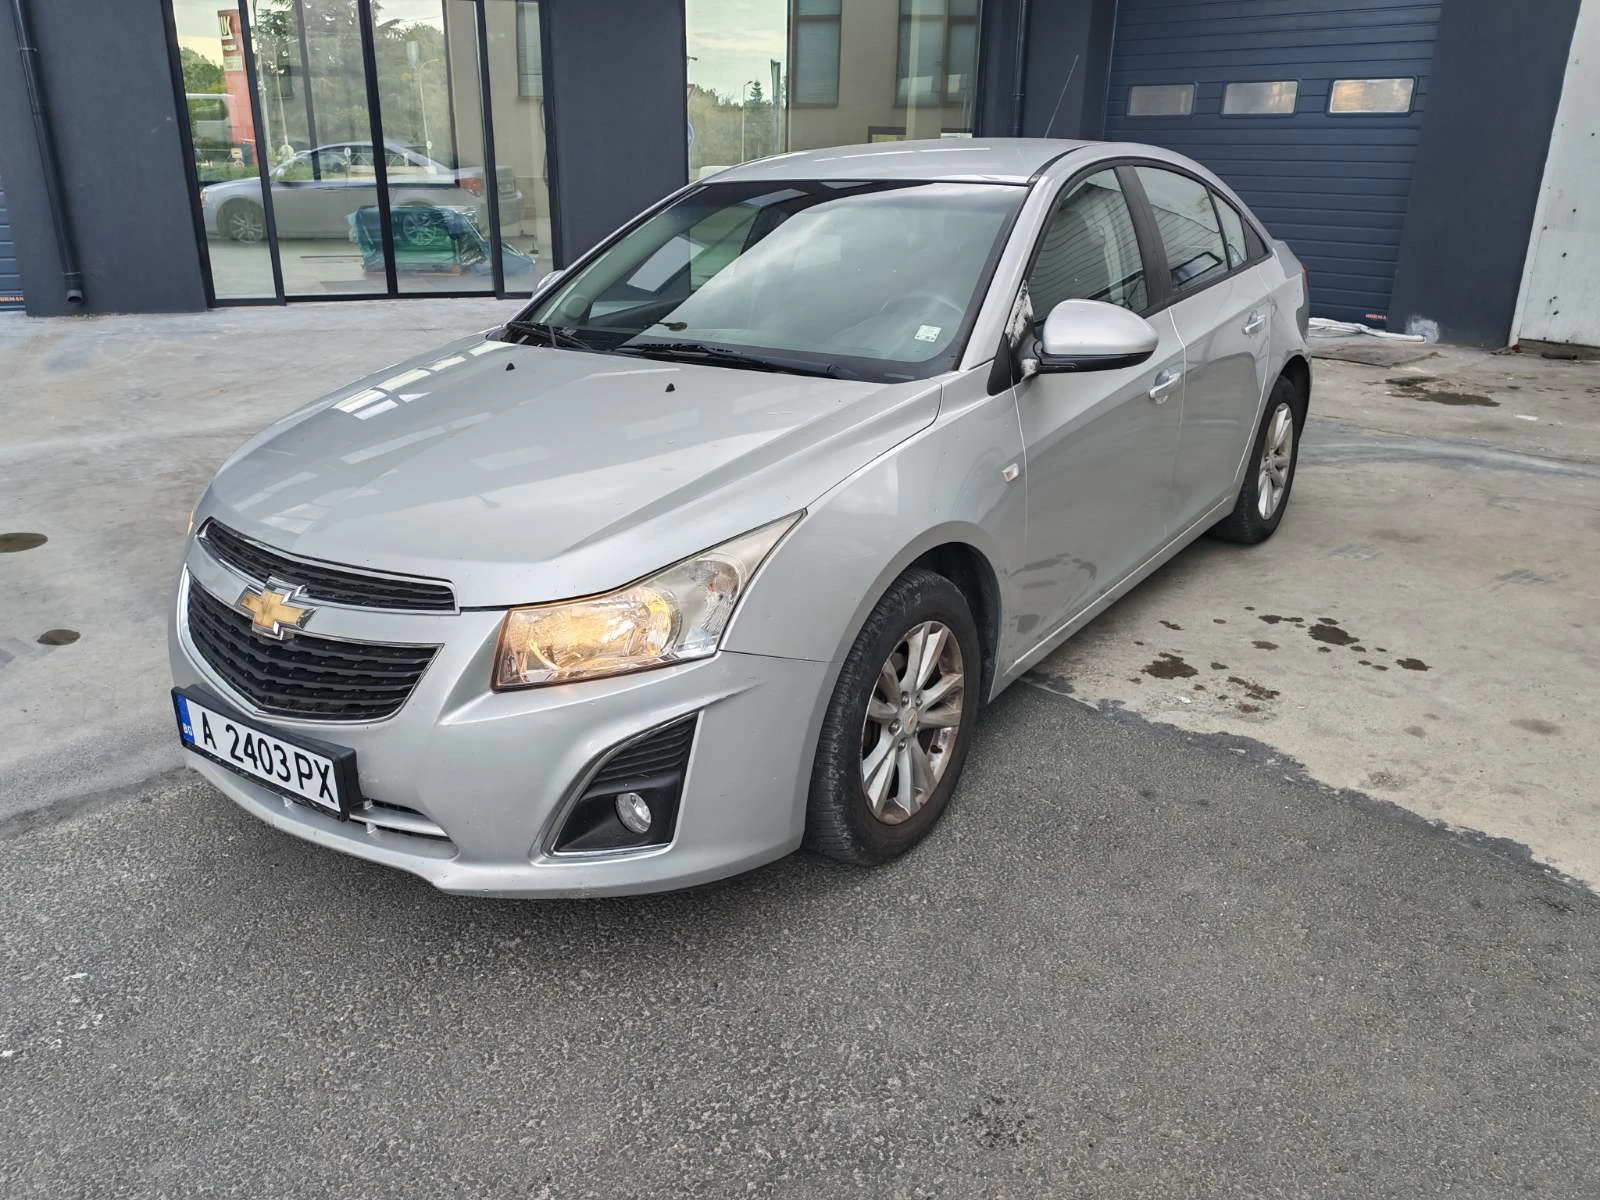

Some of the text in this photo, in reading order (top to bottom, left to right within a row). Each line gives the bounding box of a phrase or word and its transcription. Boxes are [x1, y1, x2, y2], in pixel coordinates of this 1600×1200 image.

[182, 722, 193, 736] BG
[202, 711, 336, 804] A 2403 PX
